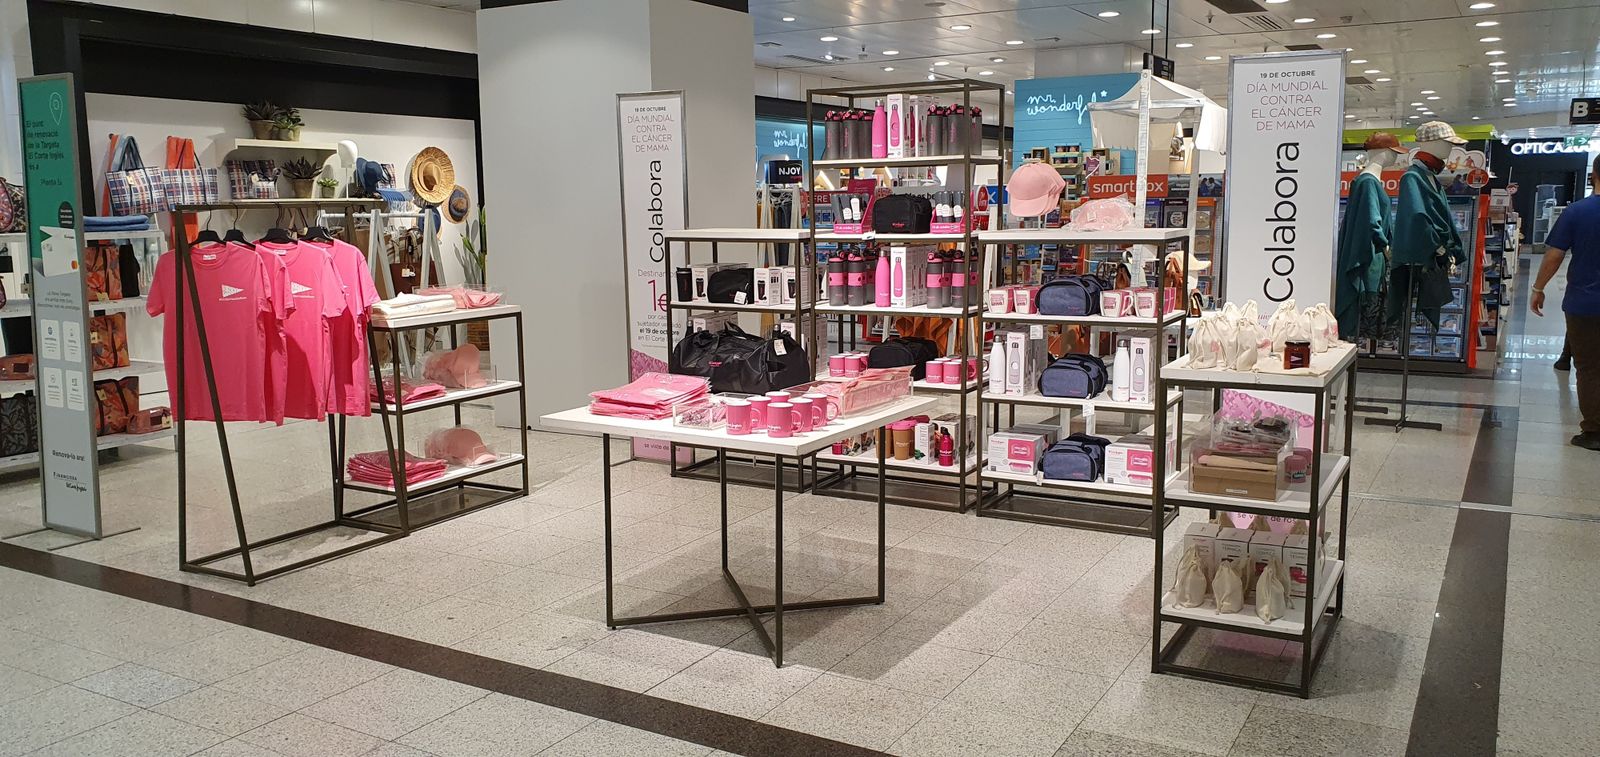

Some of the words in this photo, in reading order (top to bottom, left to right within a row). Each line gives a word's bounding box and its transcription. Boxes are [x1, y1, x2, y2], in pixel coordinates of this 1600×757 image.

[1246, 81, 1268, 93] DÍA
[1271, 80, 1328, 92] MUNDIAL
[1260, 94, 1314, 106] CONTRA
[1027, 92, 1097, 125] wonderfl
[1251, 109, 1266, 118] EL
[1269, 105, 1322, 118] CÁNCER
[1573, 101, 1589, 118] B
[627, 115, 640, 124] DÍA
[641, 114, 675, 123] MUNDIAL
[636, 125, 667, 133] CONTRA
[1256, 121, 1273, 131] DE
[1276, 120, 1316, 130] MAMA
[631, 135, 641, 143] EL
[642, 133, 673, 142] CÁNCER
[646, 144, 670, 152] MAMA
[778, 167, 801, 176] NJOY
[1093, 181, 1164, 193] smartox
[648, 160, 664, 262] Colabora
[1263, 141, 1300, 303] Colabora
